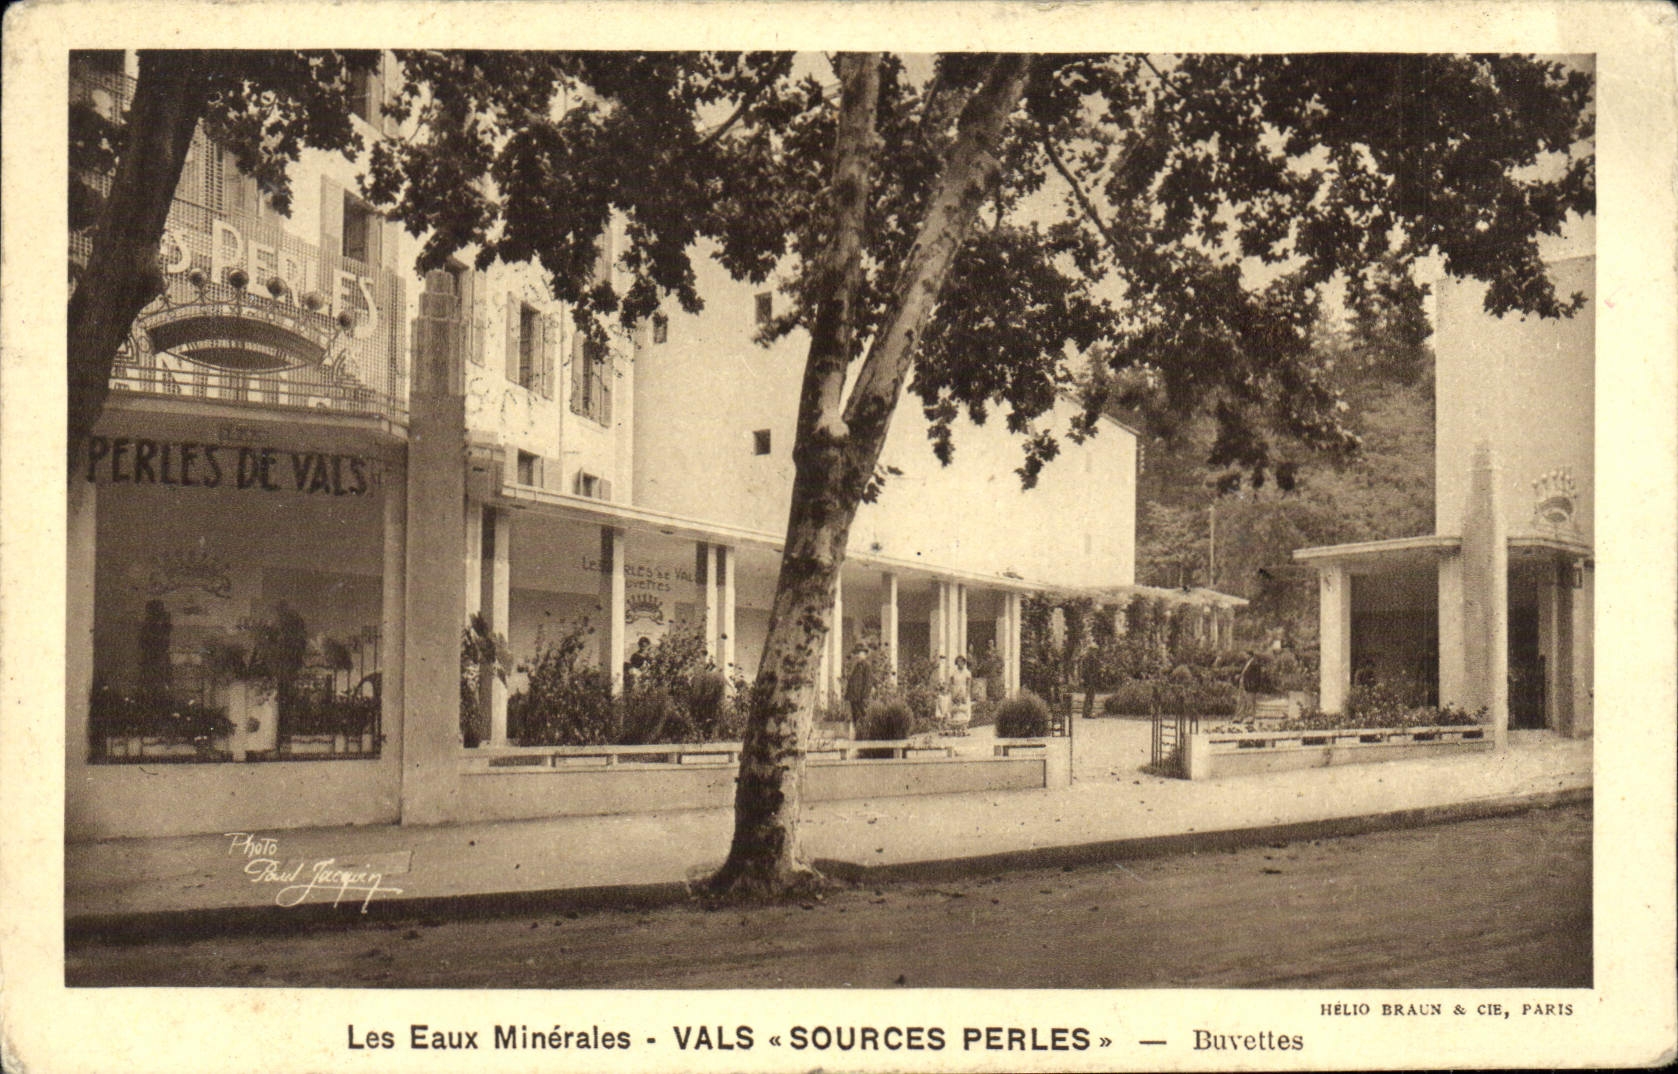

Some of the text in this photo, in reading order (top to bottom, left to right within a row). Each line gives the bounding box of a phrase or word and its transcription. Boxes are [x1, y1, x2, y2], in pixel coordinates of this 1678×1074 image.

[210, 219, 379, 339] PERLES
[86, 436, 368, 497] PERLES DE VALS
